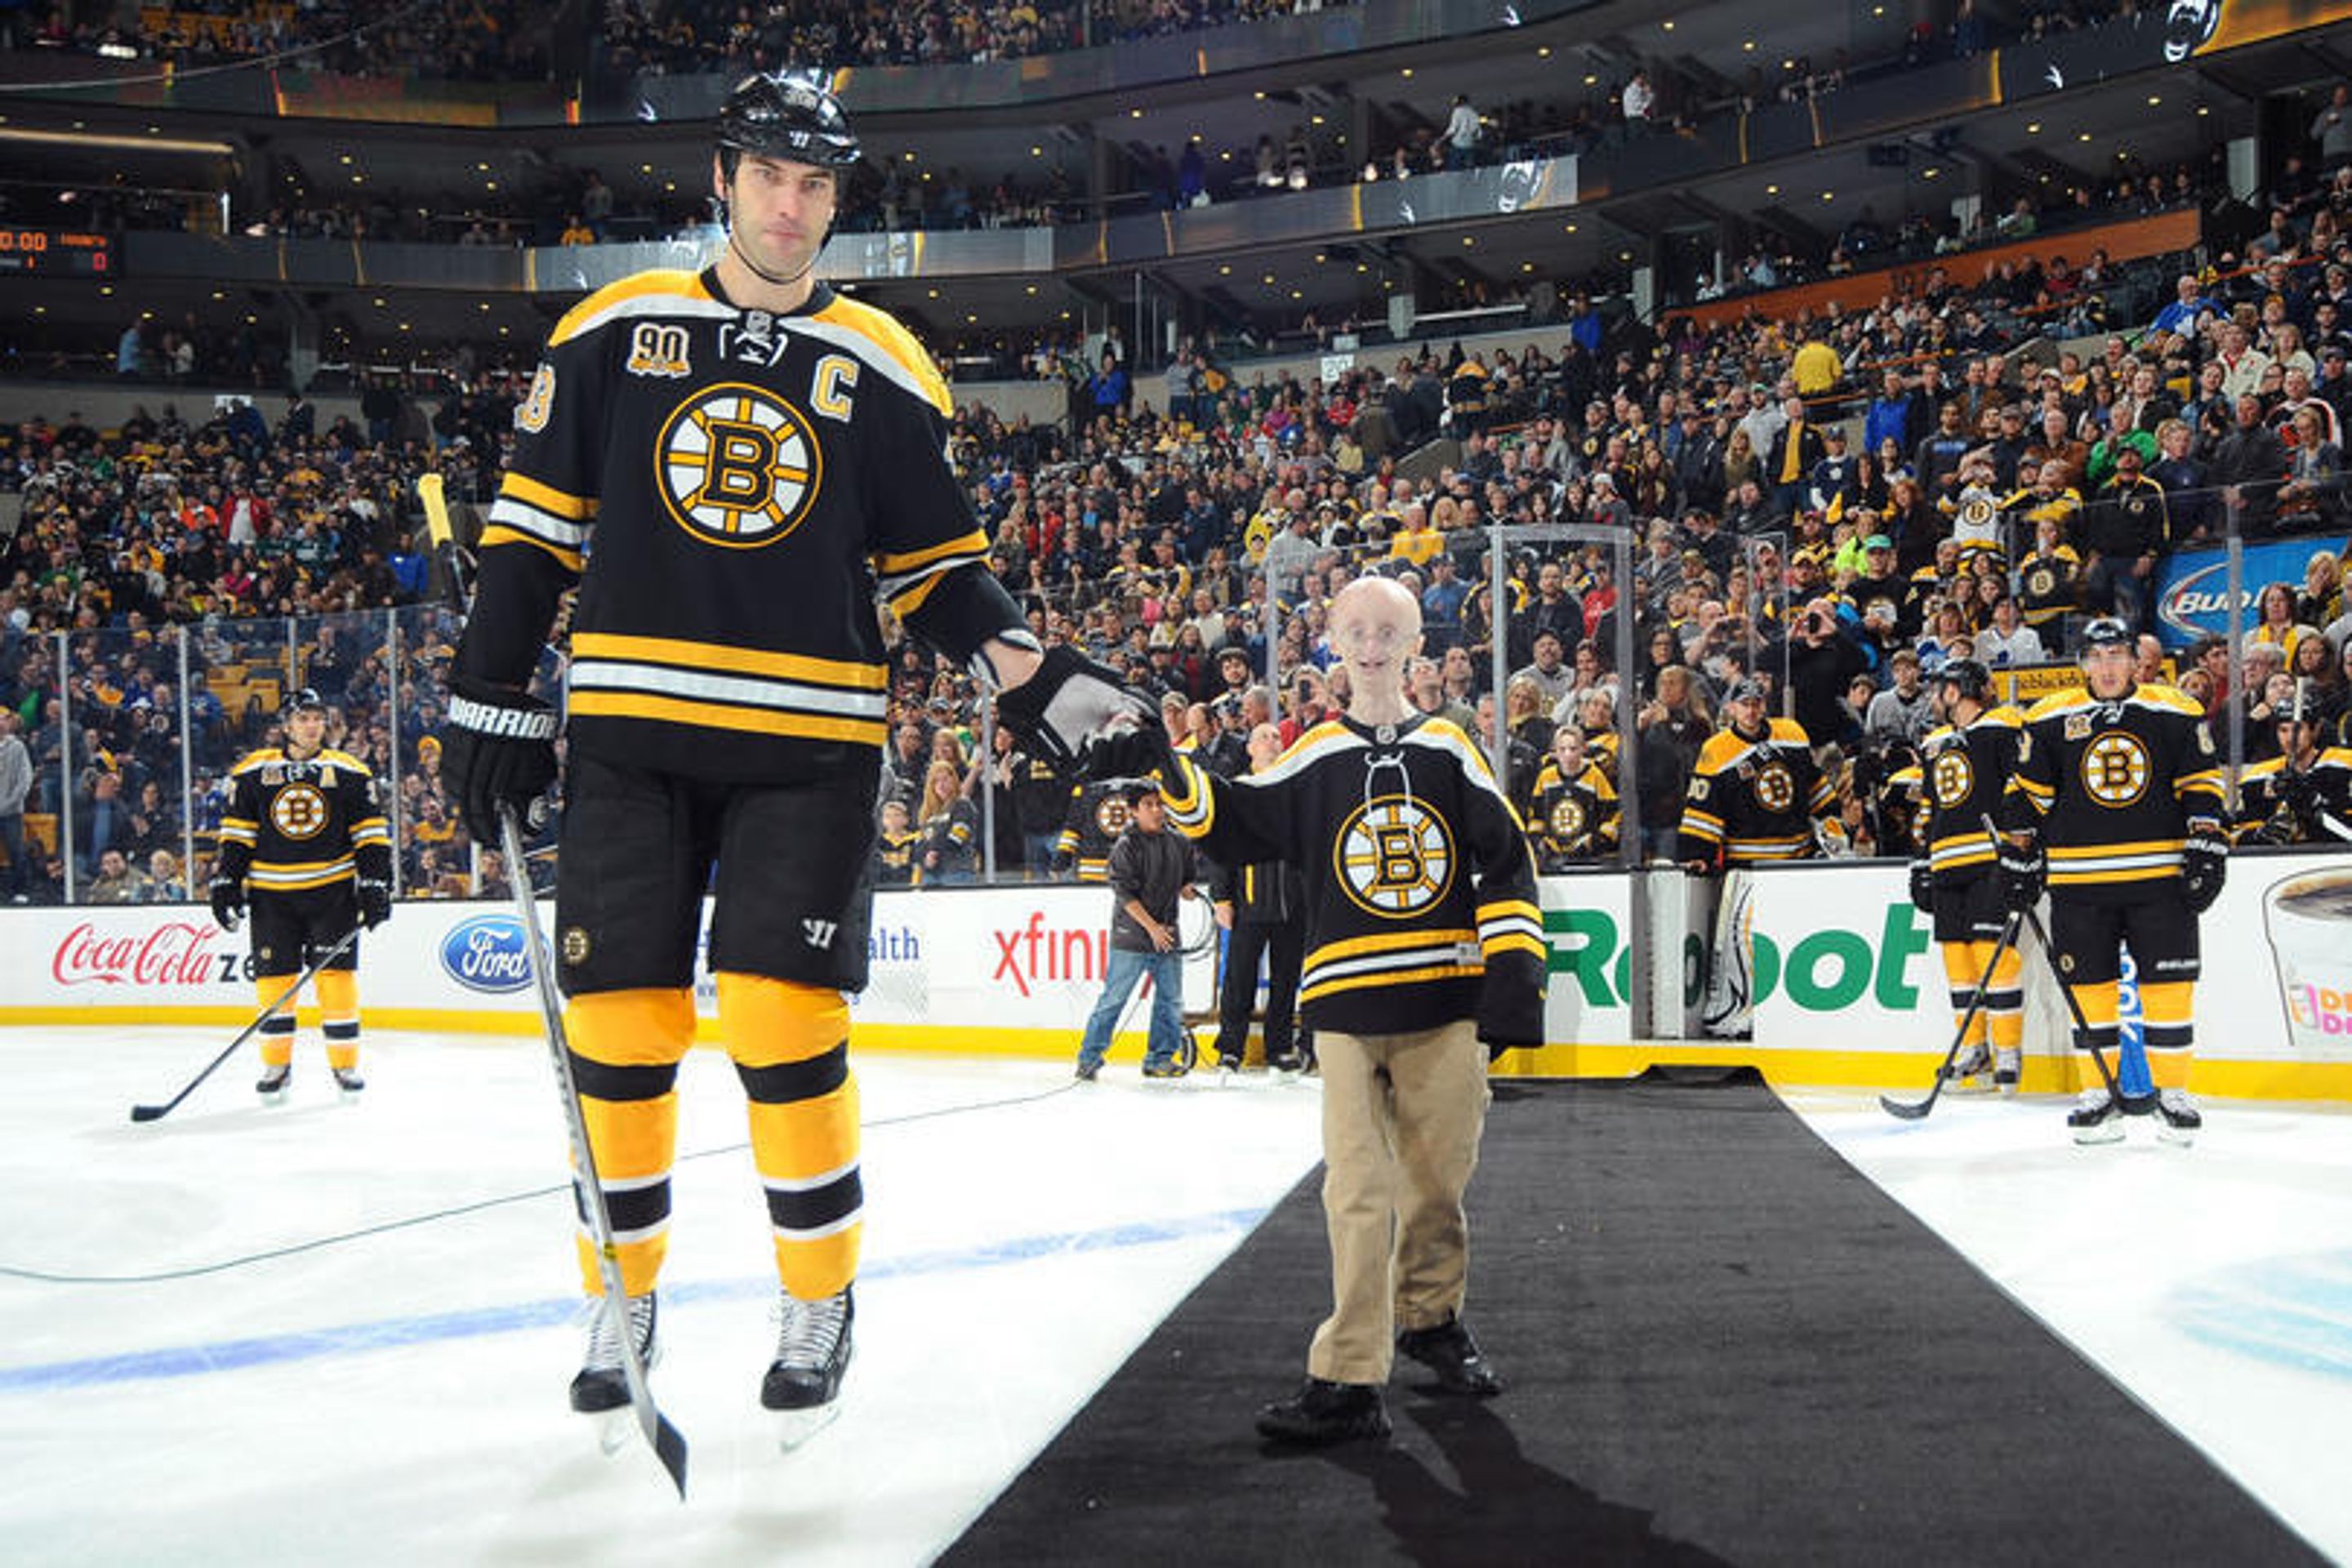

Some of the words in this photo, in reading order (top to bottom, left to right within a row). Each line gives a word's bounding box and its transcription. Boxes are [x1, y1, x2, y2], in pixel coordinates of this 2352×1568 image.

[634, 323, 689, 364] 90
[811, 354, 858, 421] C
[697, 418, 778, 511] B
[1373, 822, 1428, 892] B
[52, 923, 221, 986] Coca-Cola
[461, 926, 528, 979] Ford
